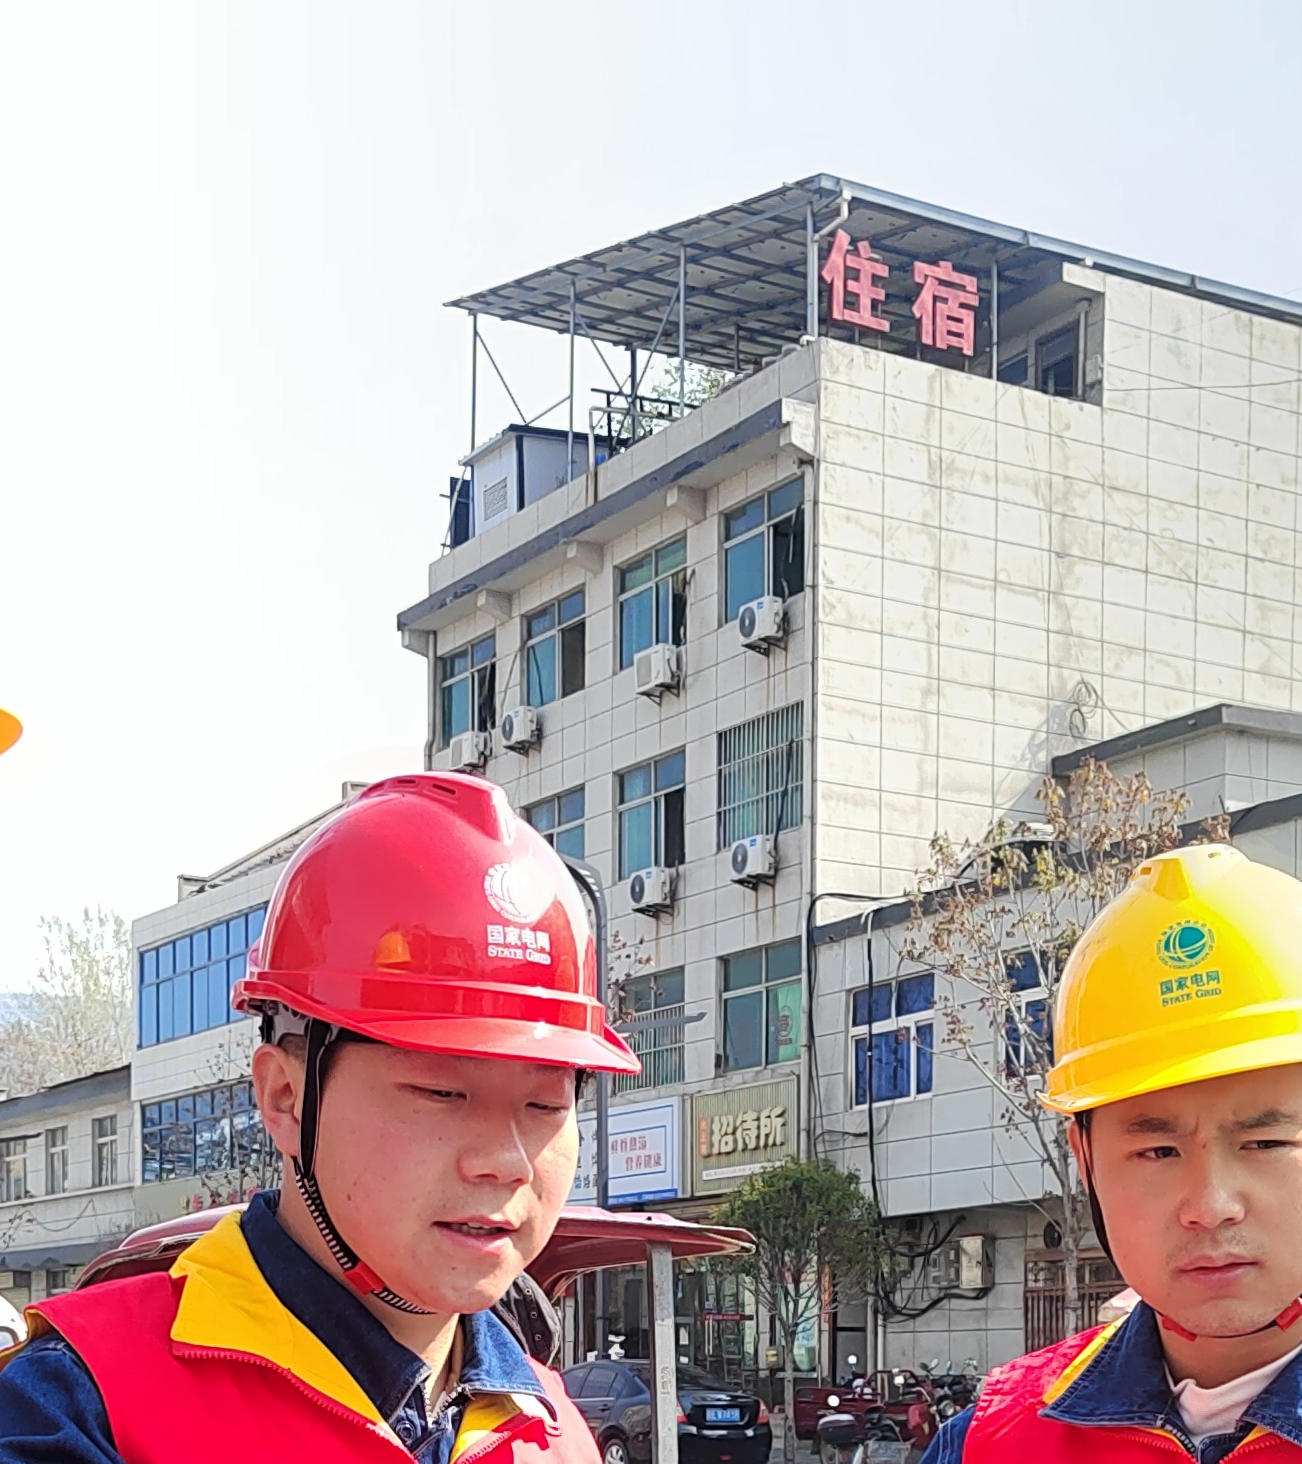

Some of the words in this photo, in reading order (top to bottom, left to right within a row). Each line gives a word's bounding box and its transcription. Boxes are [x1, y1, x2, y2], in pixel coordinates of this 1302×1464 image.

[821, 228, 980, 357] 住宿
[487, 924, 551, 953] 国家电网
[488, 945, 524, 960] STATE
[1160, 970, 1220, 996] 国家电网
[1162, 993, 1193, 1008] STATE
[1195, 988, 1222, 999] GRID
[711, 1106, 786, 1155] 招待所
